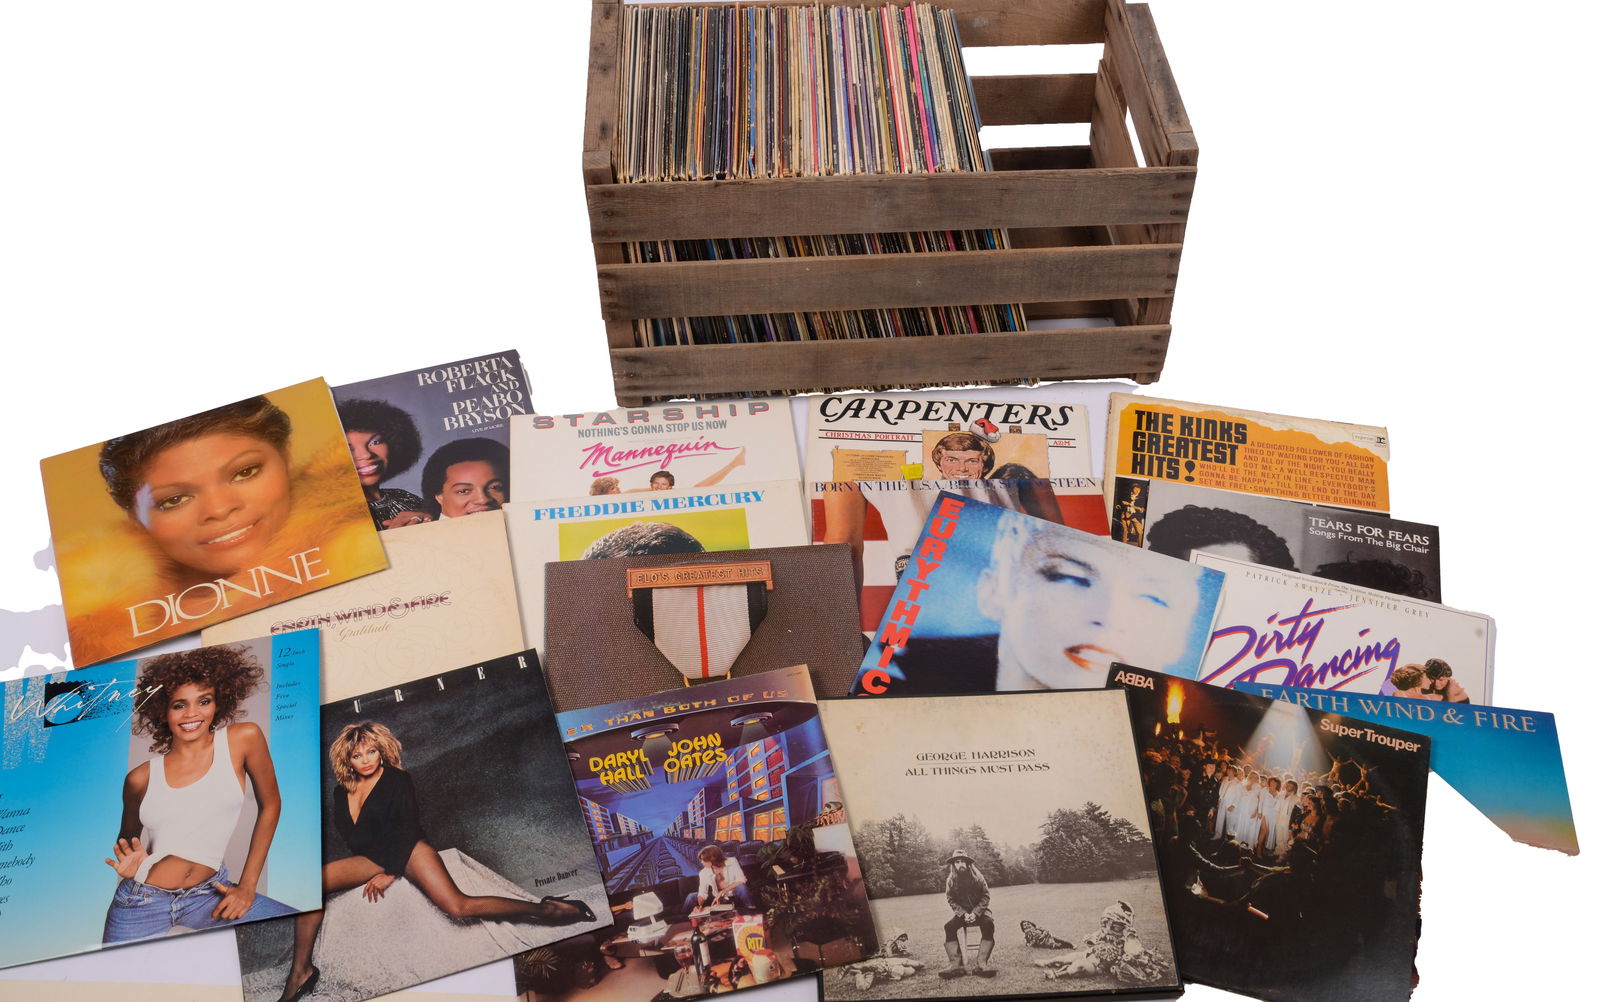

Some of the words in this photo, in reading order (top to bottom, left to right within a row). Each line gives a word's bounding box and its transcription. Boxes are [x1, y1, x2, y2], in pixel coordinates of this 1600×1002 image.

[417, 356, 514, 386] ROBERTA
[446, 369, 518, 393] FLACK
[491, 380, 520, 393] AND
[452, 389, 523, 415] PEABO
[819, 397, 1074, 432] CARPENTERS
[443, 402, 526, 431] BRYSON
[532, 401, 770, 430] STARSHIP
[1135, 410, 1174, 435] THE
[1180, 415, 1248, 445] KINKS
[577, 426, 630, 439] NOTHING'S
[631, 423, 664, 436] GONNA
[666, 421, 690, 433] STOP
[692, 420, 704, 431] US
[706, 419, 727, 430] NOW
[825, 431, 873, 441] CHRISTMAS
[874, 434, 915, 442] PORTRAIT
[579, 436, 742, 470] Mannequin
[1131, 431, 1239, 466] GREATEST
[1244, 447, 1265, 456] TIRED
[1278, 451, 1307, 462] WAITING
[1309, 456, 1323, 464] FOR
[1325, 458, 1340, 466] YOU
[1346, 460, 1358, 469] ALL
[1360, 462, 1375, 470] DAY
[1257, 441, 1295, 453] DEDICATED
[1296, 446, 1334, 457] FOLLOWER
[1334, 451, 1343, 459] OF
[1344, 453, 1374, 463] FASHION
[1131, 453, 1197, 482] HITS!
[1230, 467, 1240, 475] BE
[1244, 469, 1257, 477] THE
[1261, 471, 1281, 480] NEXT
[1295, 474, 1313, 483] LINE
[1243, 454, 1259, 462] AND
[1261, 456, 1274, 464] ALL
[1287, 460, 1301, 468] THE
[1303, 462, 1327, 471] NIGHT
[1330, 466, 1346, 474] YOU
[1348, 468, 1375, 478] REALLY
[1243, 461, 1258, 469] GOT
[1262, 464, 1273, 472] ME
[1288, 468, 1308, 477] WELL
[1309, 471, 1355, 483] RESPECTED
[1358, 476, 1376, 485] MAN
[815, 481, 853, 493] BORN
[857, 480, 873, 492] IN
[875, 480, 907, 491] THE
[1199, 477, 1213, 486] SET
[1215, 480, 1226, 488] ME
[1229, 481, 1248, 490] FREE
[1253, 485, 1299, 498] SOMETHING
[1302, 492, 1331, 502] BETTER
[1333, 496, 1377, 508] BEGINNING
[1200, 470, 1226, 480] GONNA
[1229, 473, 1239, 481] BE
[1242, 476, 1268, 486] HAPPY
[1276, 481, 1292, 489] TILL
[1295, 482, 1309, 491] THE
[1312, 485, 1328, 494] END
[1330, 488, 1339, 496] OF
[1343, 490, 1358, 498] THE
[1361, 492, 1376, 500] DAY
[533, 499, 645, 522] FREDDIE
[650, 489, 767, 512] MERCURY
[1308, 516, 1353, 533] TEARS
[1357, 524, 1385, 538] FOR
[1389, 530, 1430, 546] FEARS
[1308, 527, 1336, 539] Songs
[1338, 532, 1364, 543] From
[1365, 536, 1384, 547] The
[1386, 540, 1401, 552] Big
[1402, 543, 1430, 554] Chair
[637, 572, 669, 584] ELO'S
[675, 568, 733, 581] GREATEST
[737, 567, 764, 577] HITS
[125, 547, 330, 638] DIONNE
[857, 496, 965, 697] EURYTHMIC
[1404, 607, 1430, 618] GREY
[338, 621, 393, 642] Gratitude
[1200, 598, 1358, 684] Dirty
[277, 647, 292, 658] 12
[1226, 628, 1400, 692] Dancing
[353, 654, 528, 714] URNER
[1114, 670, 1155, 690] ABBA
[11, 677, 164, 733] Whitney
[604, 711, 655, 726] THAN
[664, 698, 718, 715] BOTH
[727, 692, 755, 704] OF
[763, 689, 788, 699] US
[1261, 688, 1349, 713] EARTH
[1357, 698, 1435, 723] WIND
[1442, 708, 1464, 725] &
[1474, 711, 1538, 733] FIRE
[668, 733, 723, 757] JOHN
[1320, 718, 1364, 739] Super
[1364, 728, 1421, 753] Trouper
[589, 748, 649, 773] DARYL
[916, 751, 967, 762] GEORGE
[972, 749, 1036, 760] HARRISON
[600, 764, 645, 785] HALL
[905, 767, 928, 777] ALL
[930, 766, 977, 776] THINGS
[980, 764, 1014, 774] MUST
[1017, 762, 1051, 772] PASS
[557, 869, 578, 881] Dancer
[746, 936, 765, 950] RITZ
